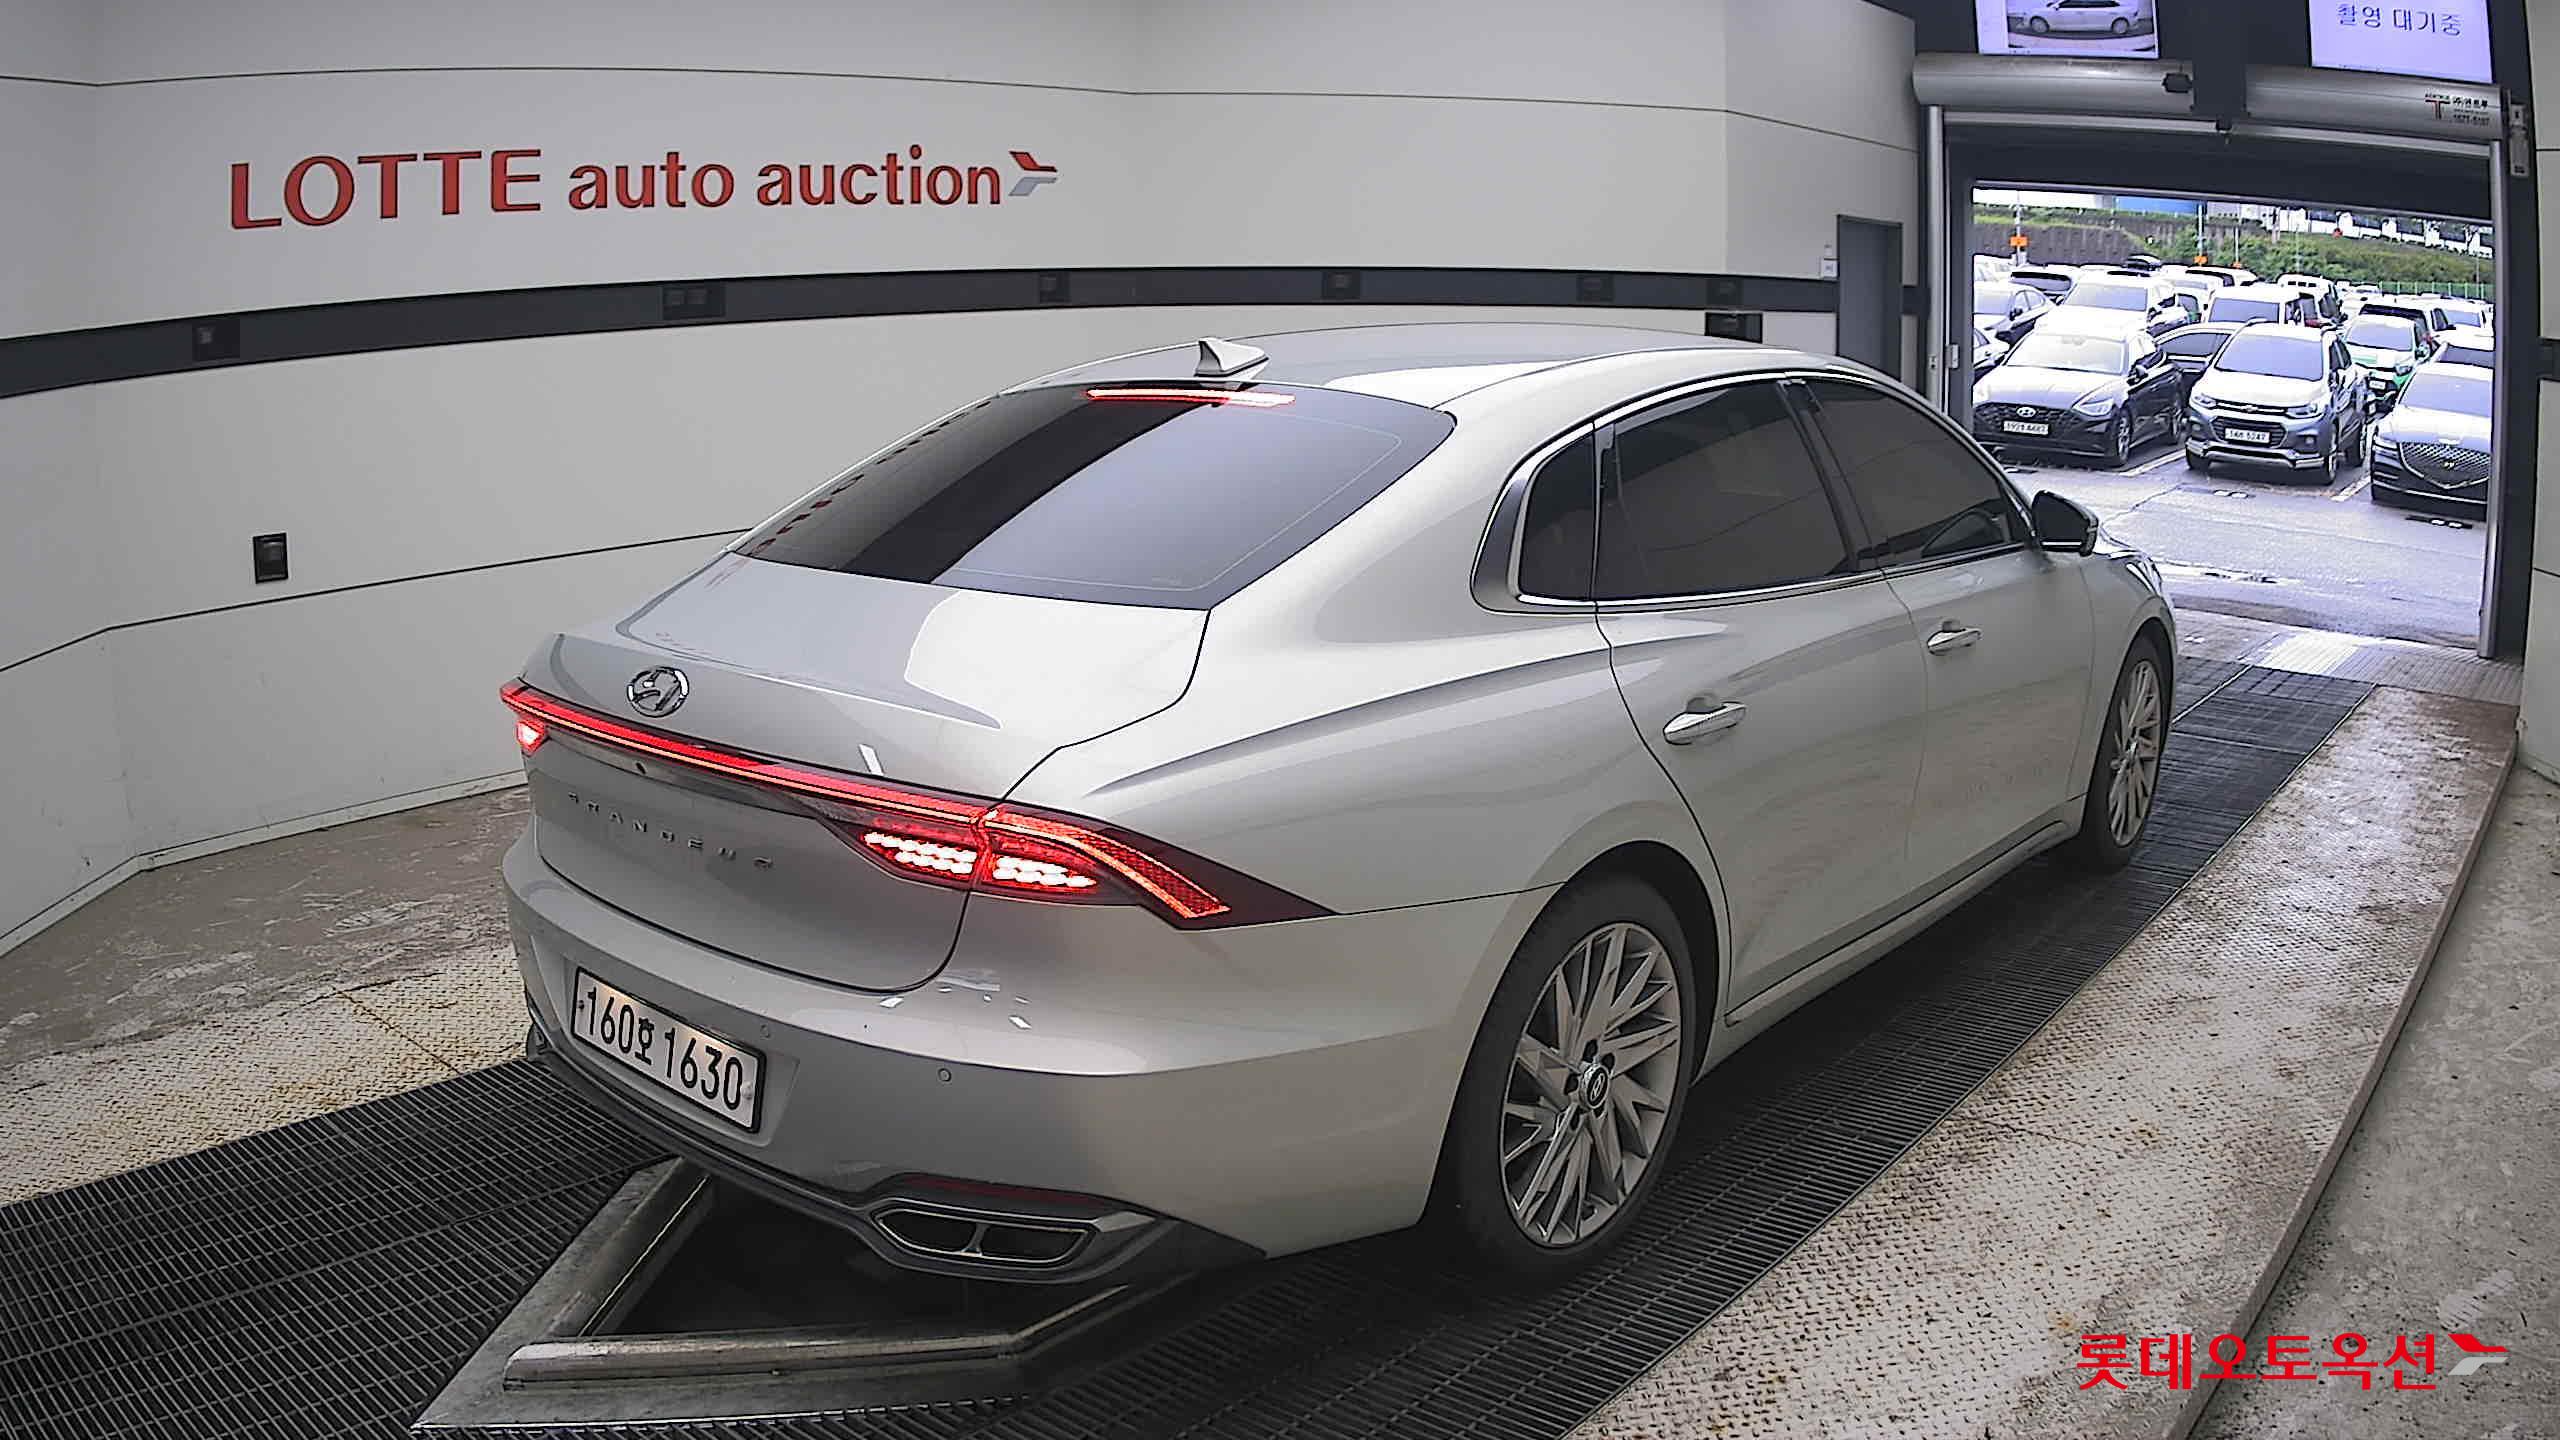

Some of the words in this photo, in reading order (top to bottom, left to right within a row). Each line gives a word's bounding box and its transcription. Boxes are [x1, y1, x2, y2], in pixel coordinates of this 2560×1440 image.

[2337, 4, 2381, 28] 촬영
[2393, 8, 2461, 36] 대기중
[231, 149, 541, 230] LOTTE
[568, 151, 734, 209] auto
[756, 144, 1001, 206] auction
[587, 987, 655, 1066] 160호
[664, 1027, 743, 1111] 1630
